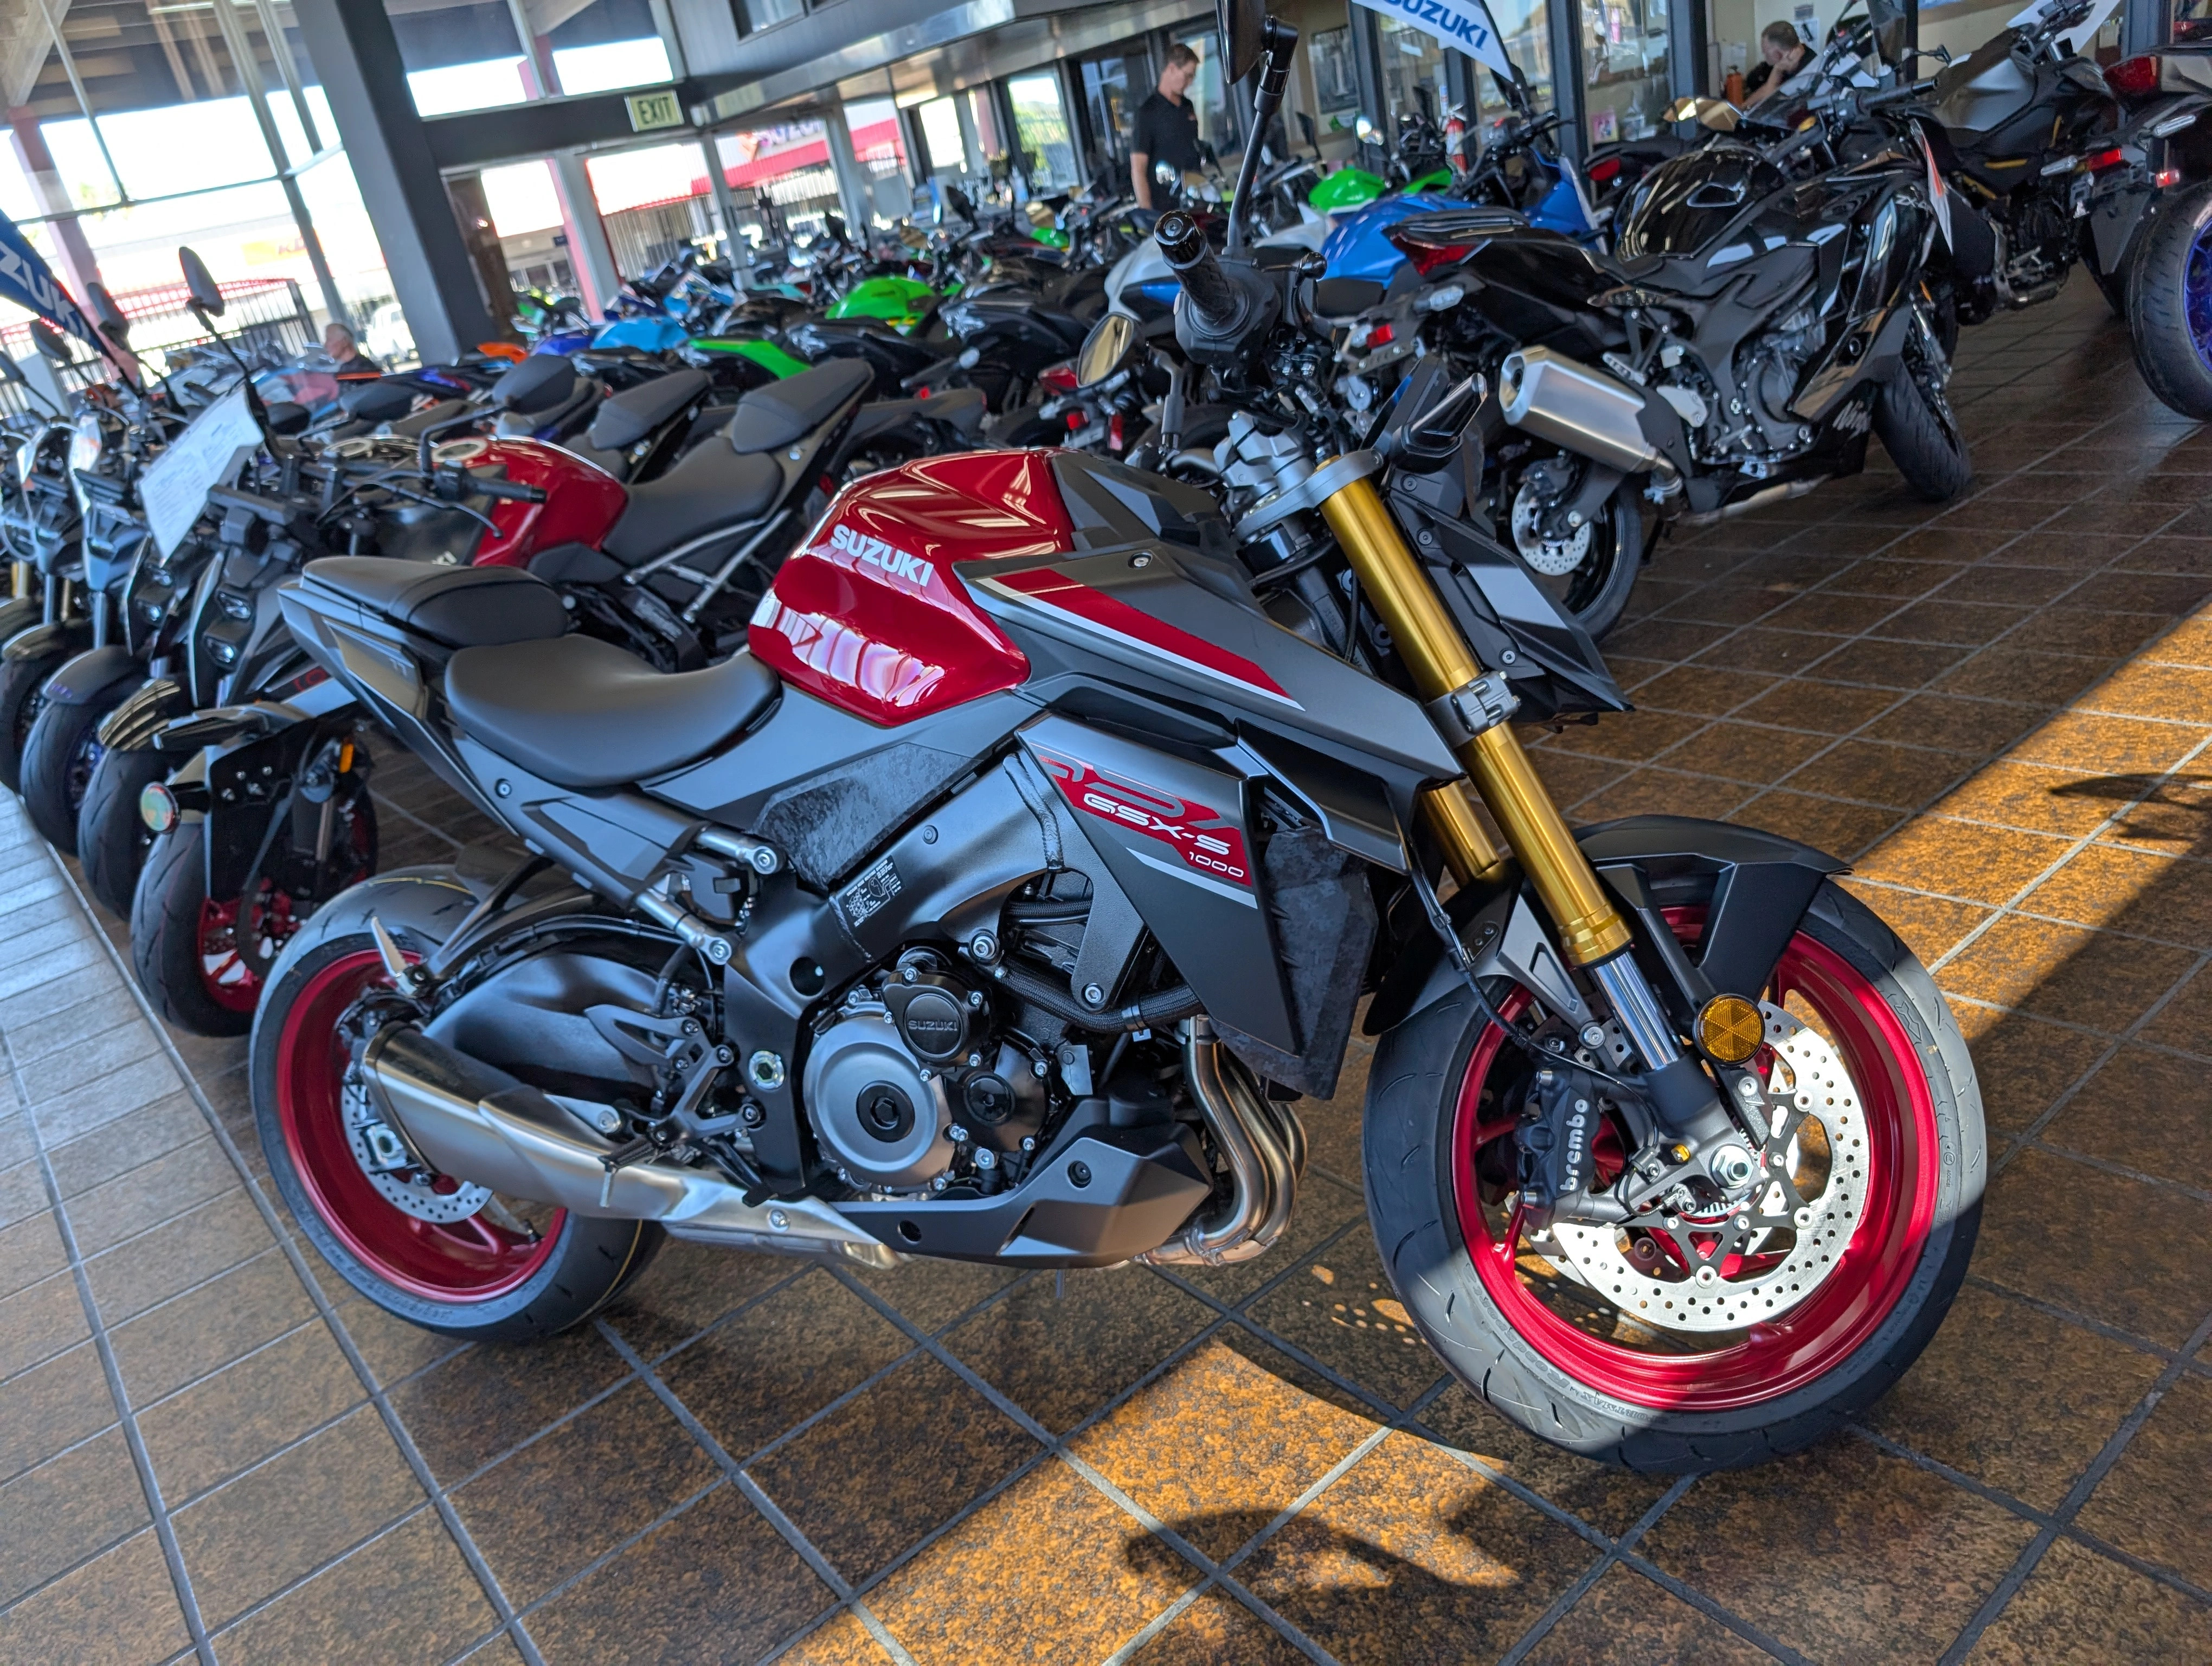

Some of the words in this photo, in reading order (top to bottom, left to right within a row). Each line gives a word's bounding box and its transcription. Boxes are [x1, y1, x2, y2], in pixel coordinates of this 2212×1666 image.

[1384, 0, 1488, 50] UZUKI
[638, 97, 672, 125] EXIT
[830, 523, 934, 587] SUZUKI
[1084, 793, 1231, 855] GSX-S
[1189, 851, 1244, 878] 1000
[908, 1020, 958, 1031] SUZUKI
[1559, 1099, 1589, 1191] brembo
